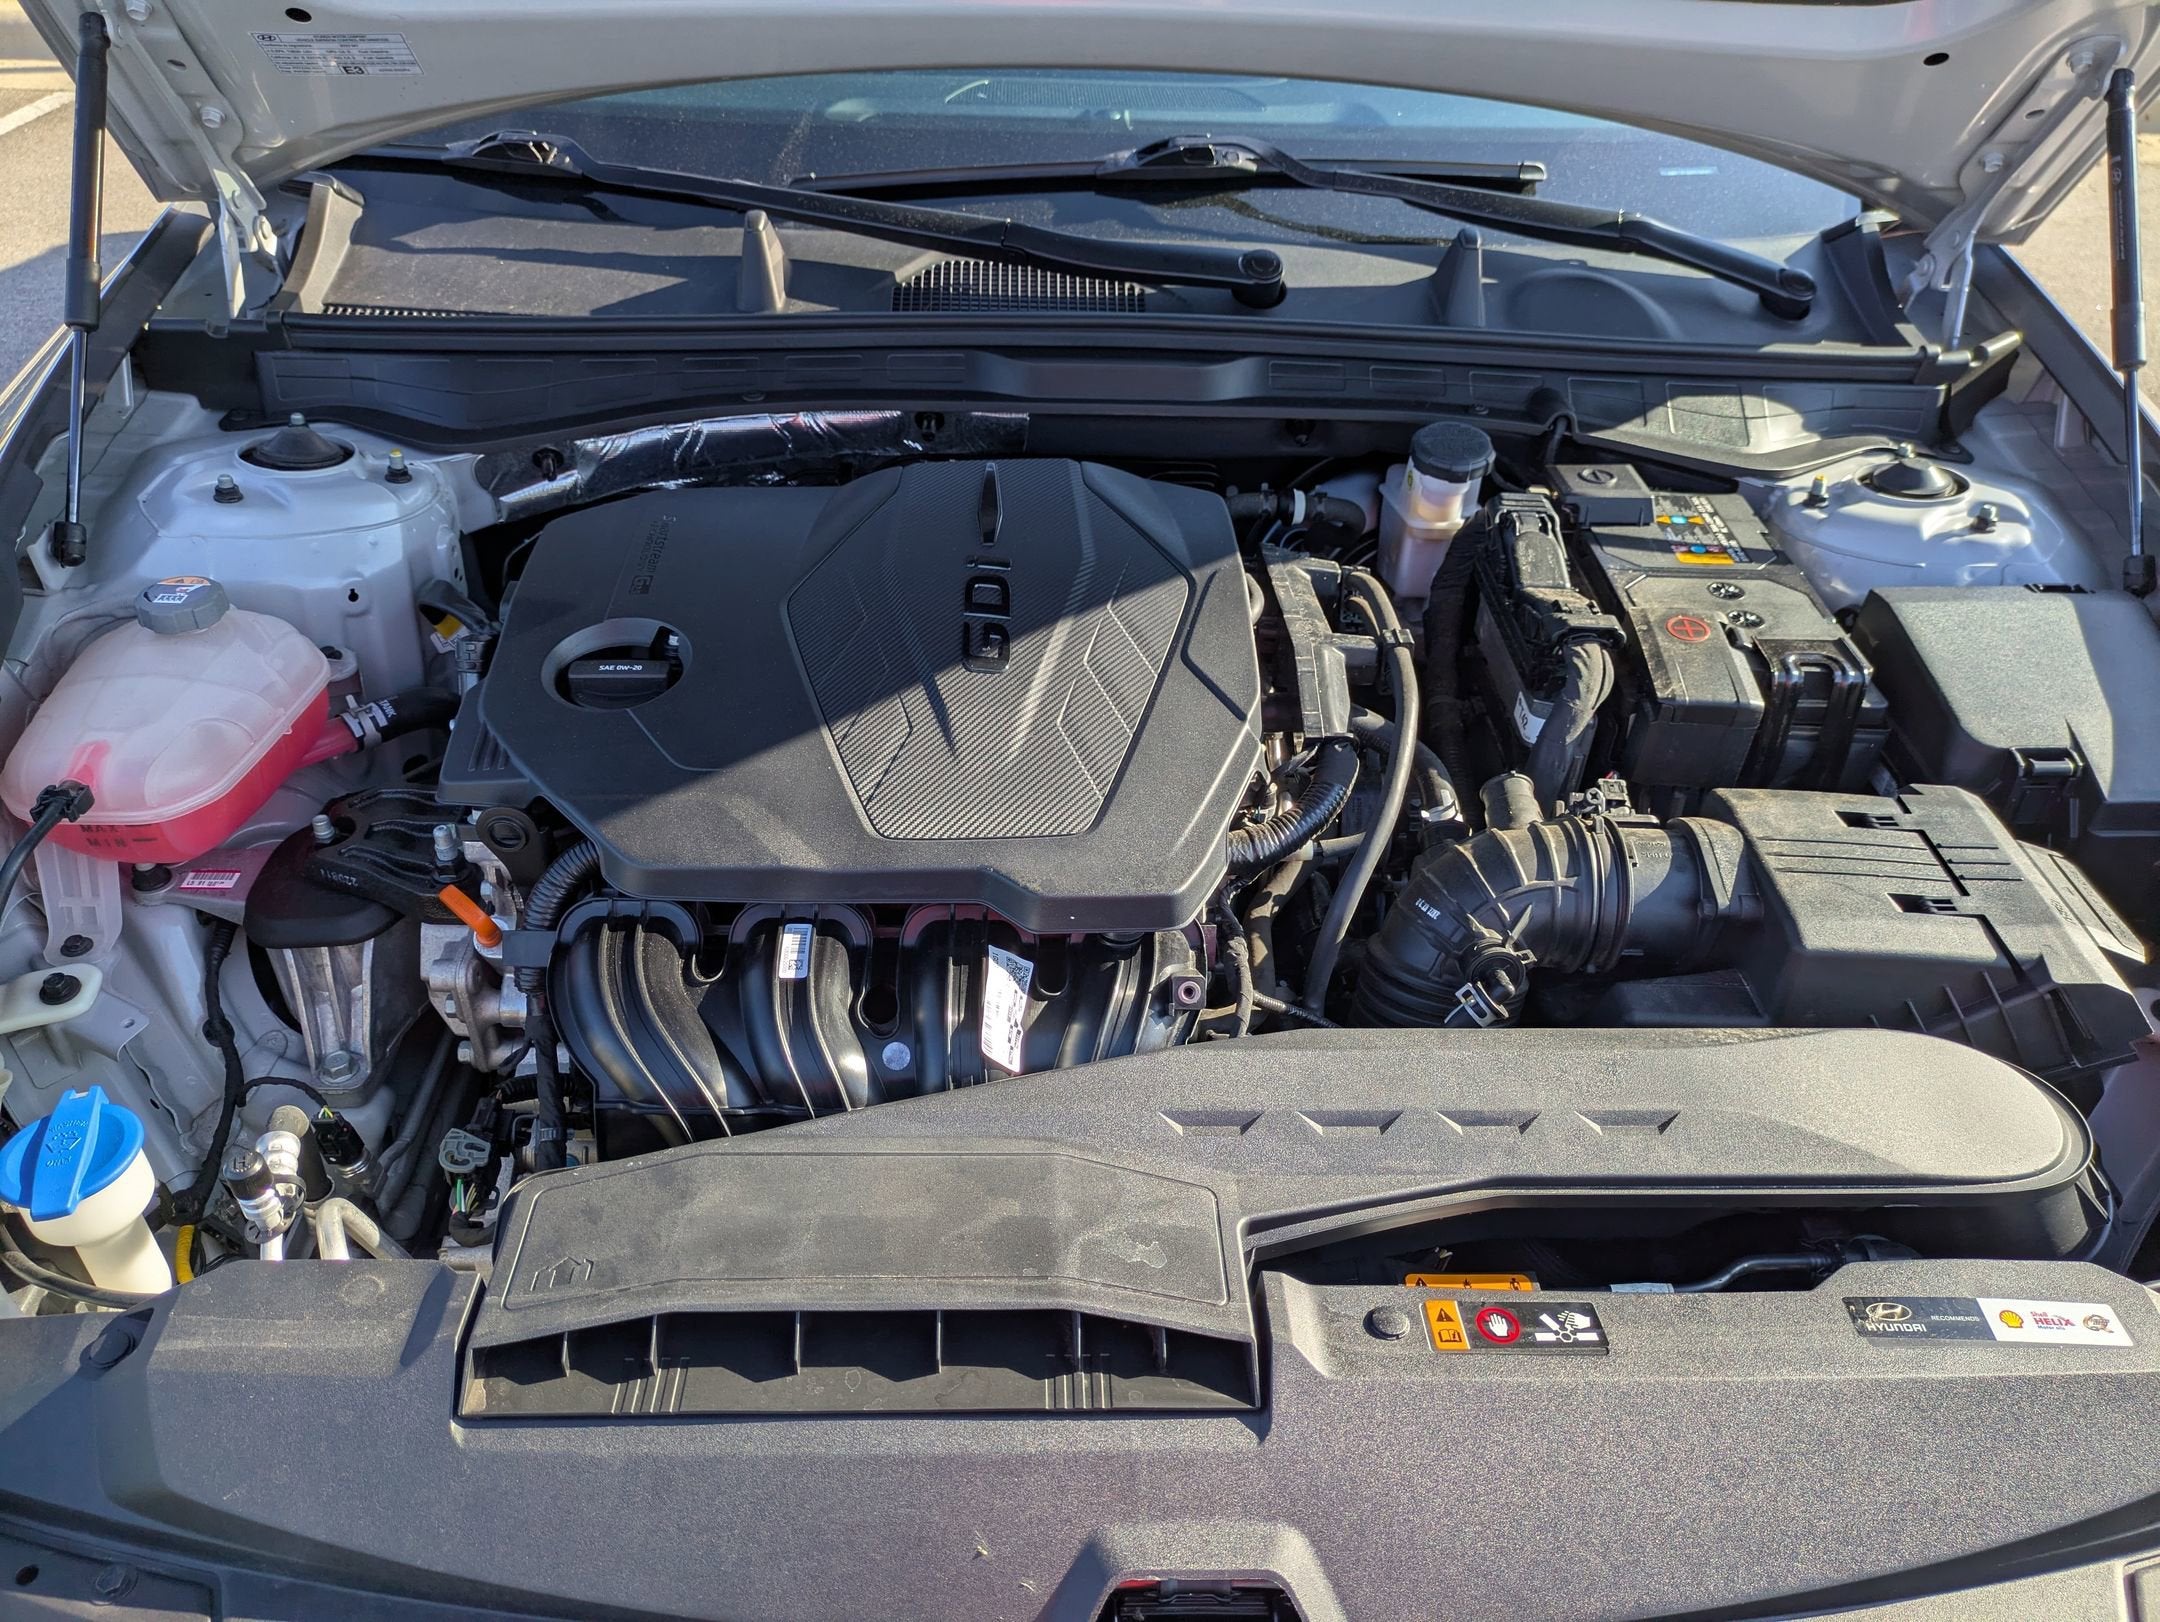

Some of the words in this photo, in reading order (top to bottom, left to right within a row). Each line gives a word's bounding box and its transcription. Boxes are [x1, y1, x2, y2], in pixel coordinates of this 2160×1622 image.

[342, 66, 365, 75] E3
[960, 556, 1012, 674] GDi
[2033, 1318, 2076, 1327] HELIX
[1866, 1323, 1927, 1333] HYUNDAI
